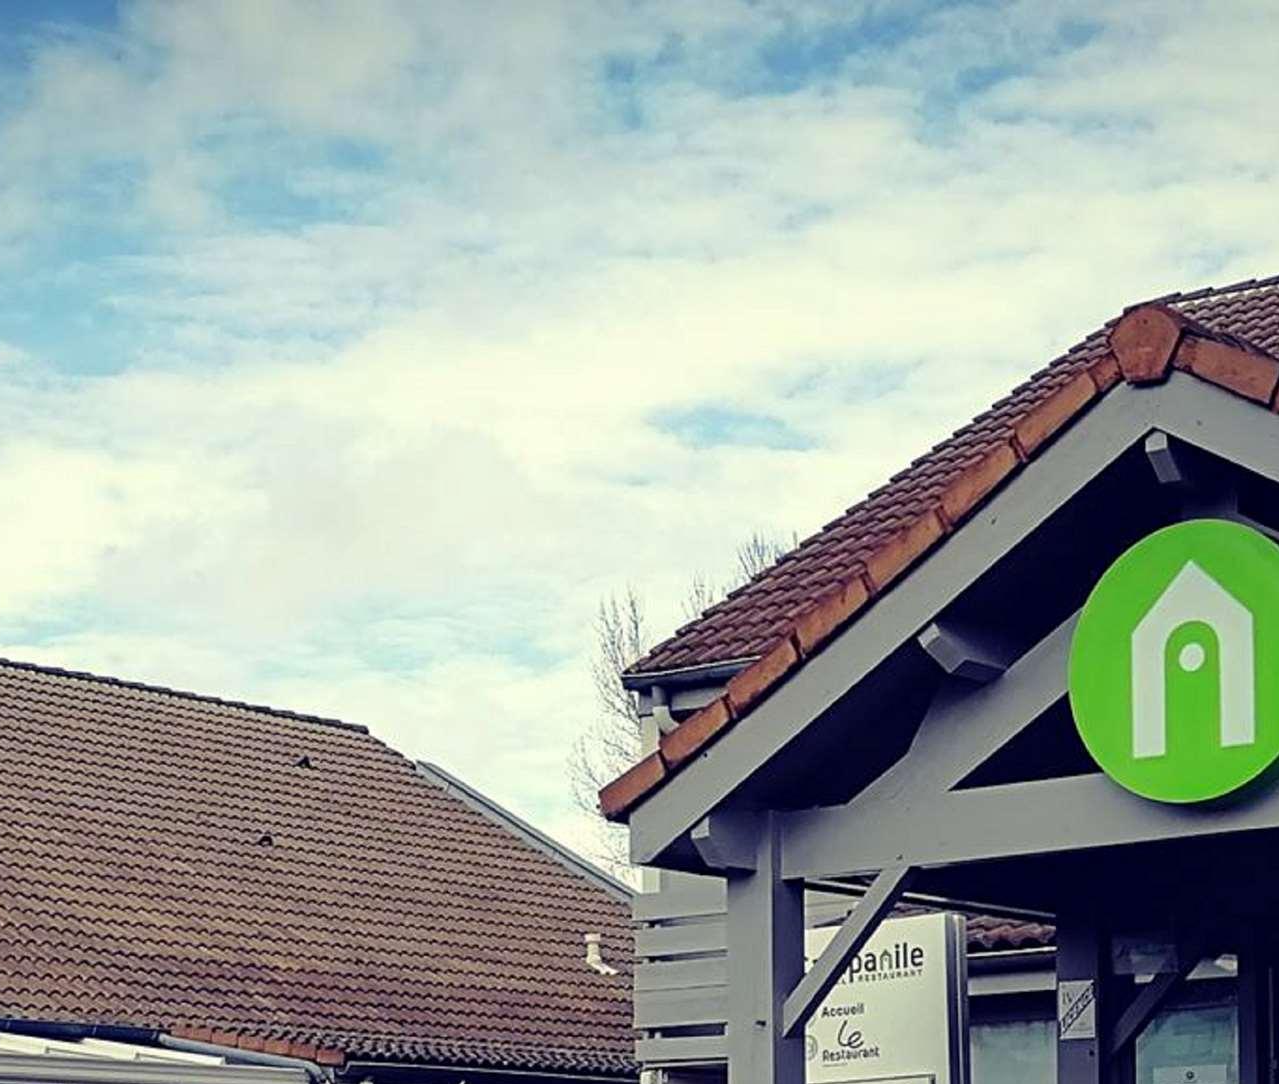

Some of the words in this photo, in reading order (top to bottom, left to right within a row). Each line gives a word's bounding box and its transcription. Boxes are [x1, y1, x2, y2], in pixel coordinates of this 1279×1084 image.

[804, 942, 924, 983] panile
[821, 1003, 864, 1018] Accueil
[822, 1047, 880, 1062] Restaurant
